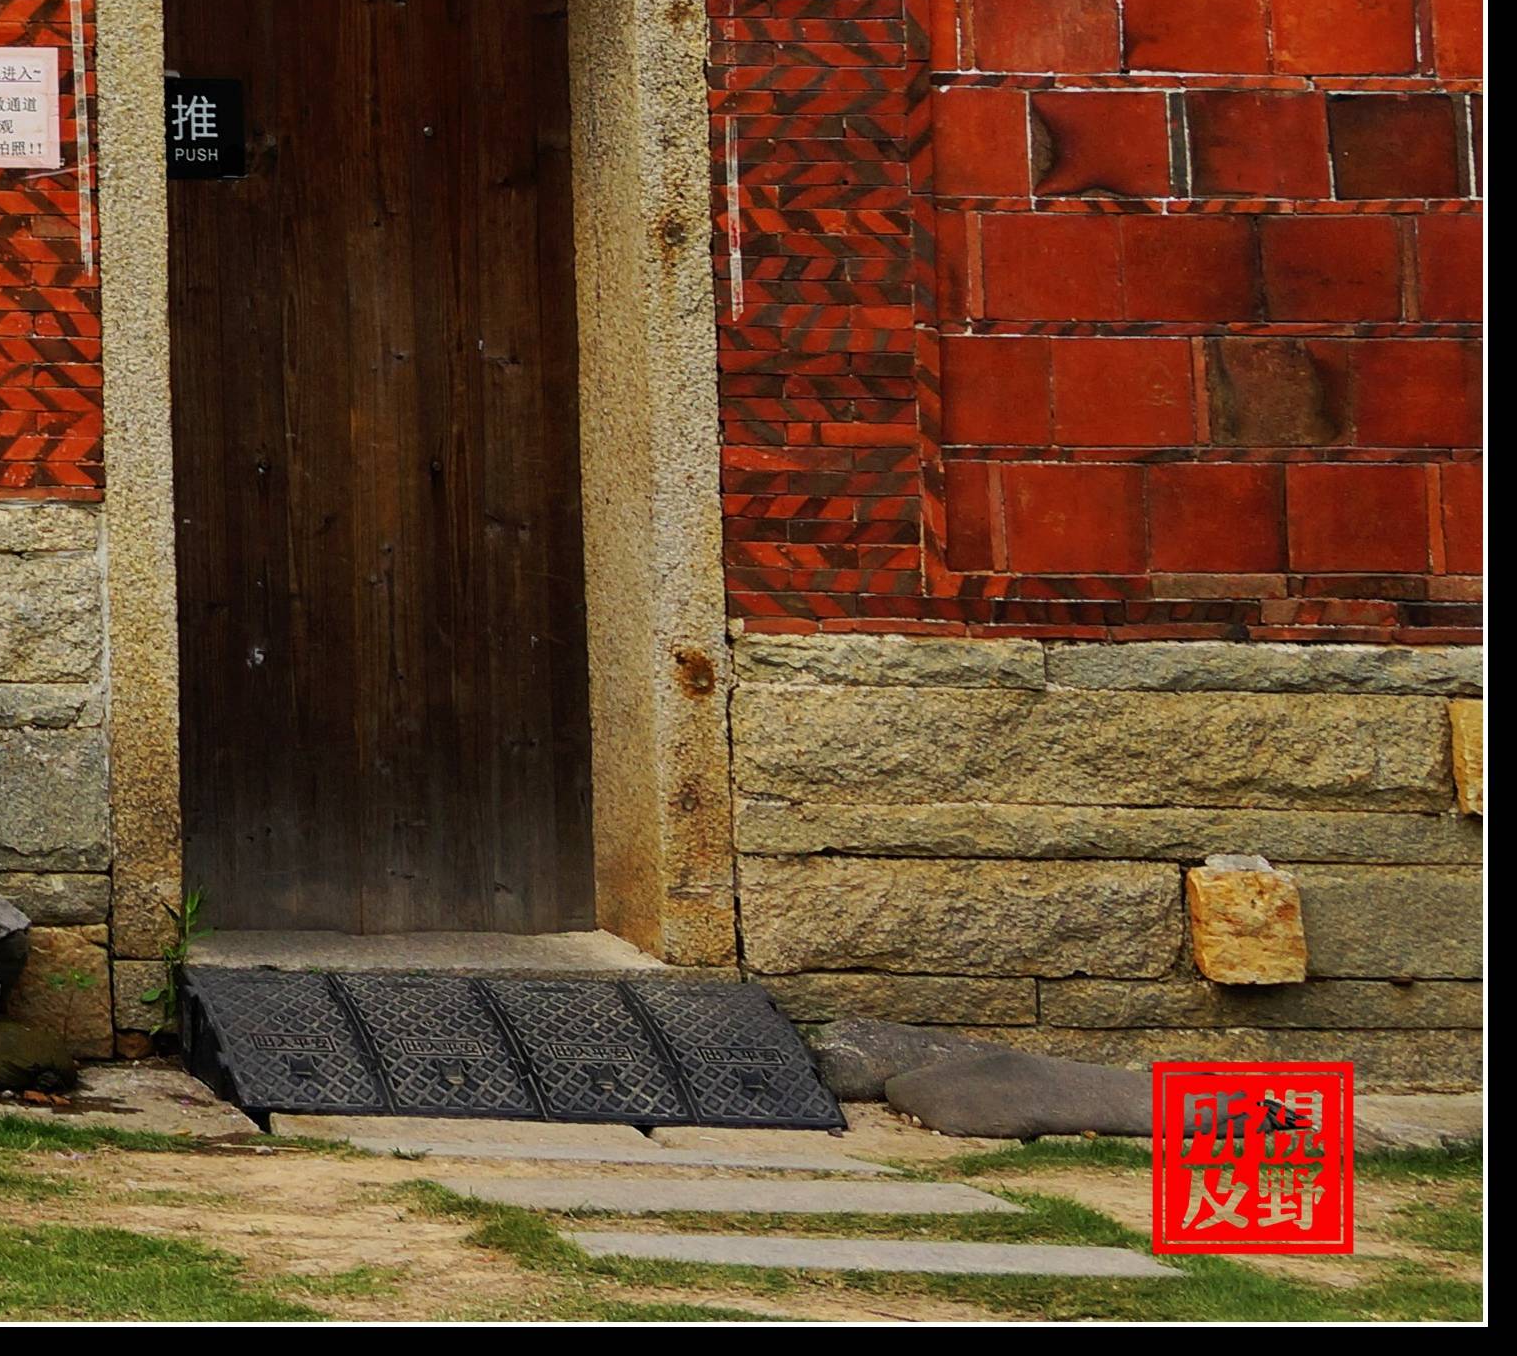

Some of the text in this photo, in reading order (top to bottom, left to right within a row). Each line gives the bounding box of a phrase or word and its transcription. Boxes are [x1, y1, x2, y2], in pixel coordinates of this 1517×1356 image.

[171, 94, 219, 141] 推
[175, 148, 219, 162] PUSH
[253, 1035, 330, 1051] 出入平安
[403, 1040, 479, 1055] 出入平安
[554, 1045, 630, 1060] 出入平安
[703, 1048, 780, 1063] 出入平安
